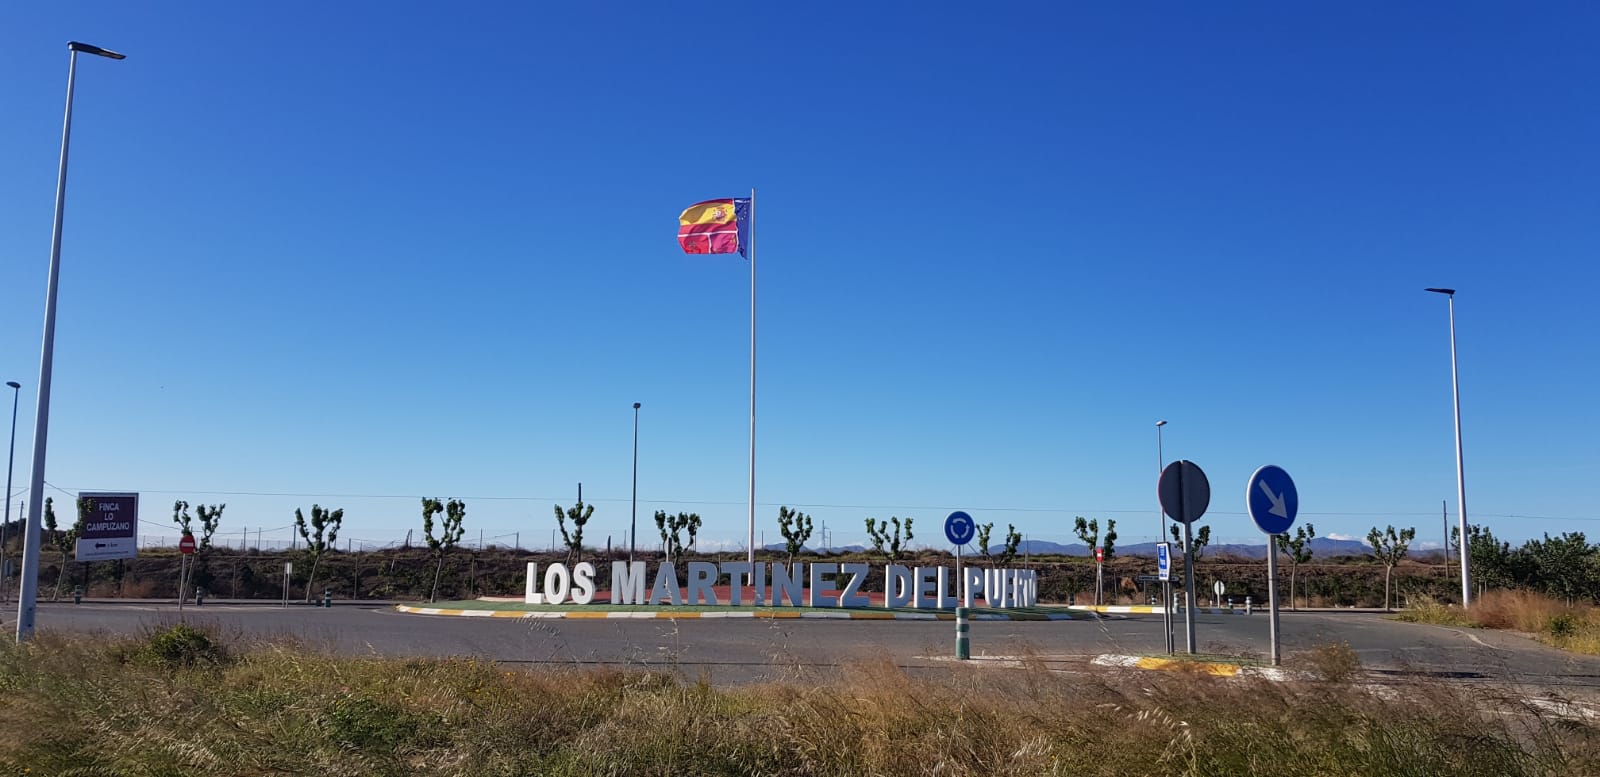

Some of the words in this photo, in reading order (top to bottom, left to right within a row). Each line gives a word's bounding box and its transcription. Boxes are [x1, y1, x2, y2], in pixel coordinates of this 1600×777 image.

[99, 503, 119, 511] FINCA
[104, 512, 113, 520] LO
[87, 522, 129, 531] CAMPUZANO
[525, 562, 596, 605] LOS
[611, 561, 870, 607] MARTINEZ
[885, 565, 957, 608] DEL
